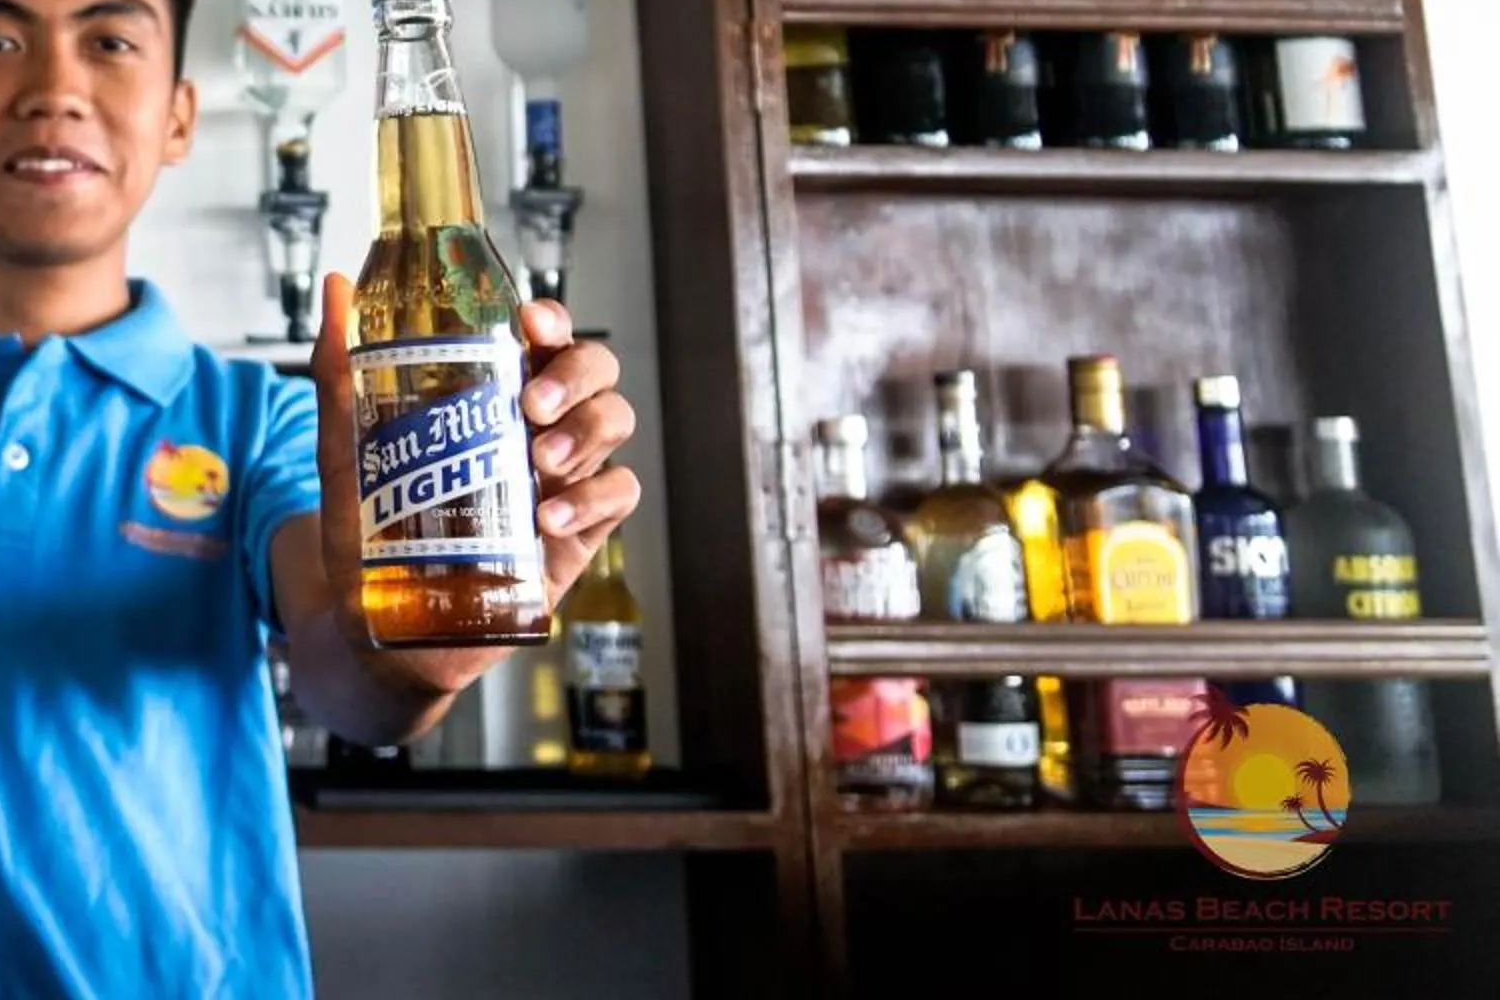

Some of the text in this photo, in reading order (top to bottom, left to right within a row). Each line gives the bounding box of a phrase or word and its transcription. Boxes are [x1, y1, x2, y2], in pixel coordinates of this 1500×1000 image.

[362, 390, 506, 485] San Mig
[374, 448, 499, 525] LIGHT
